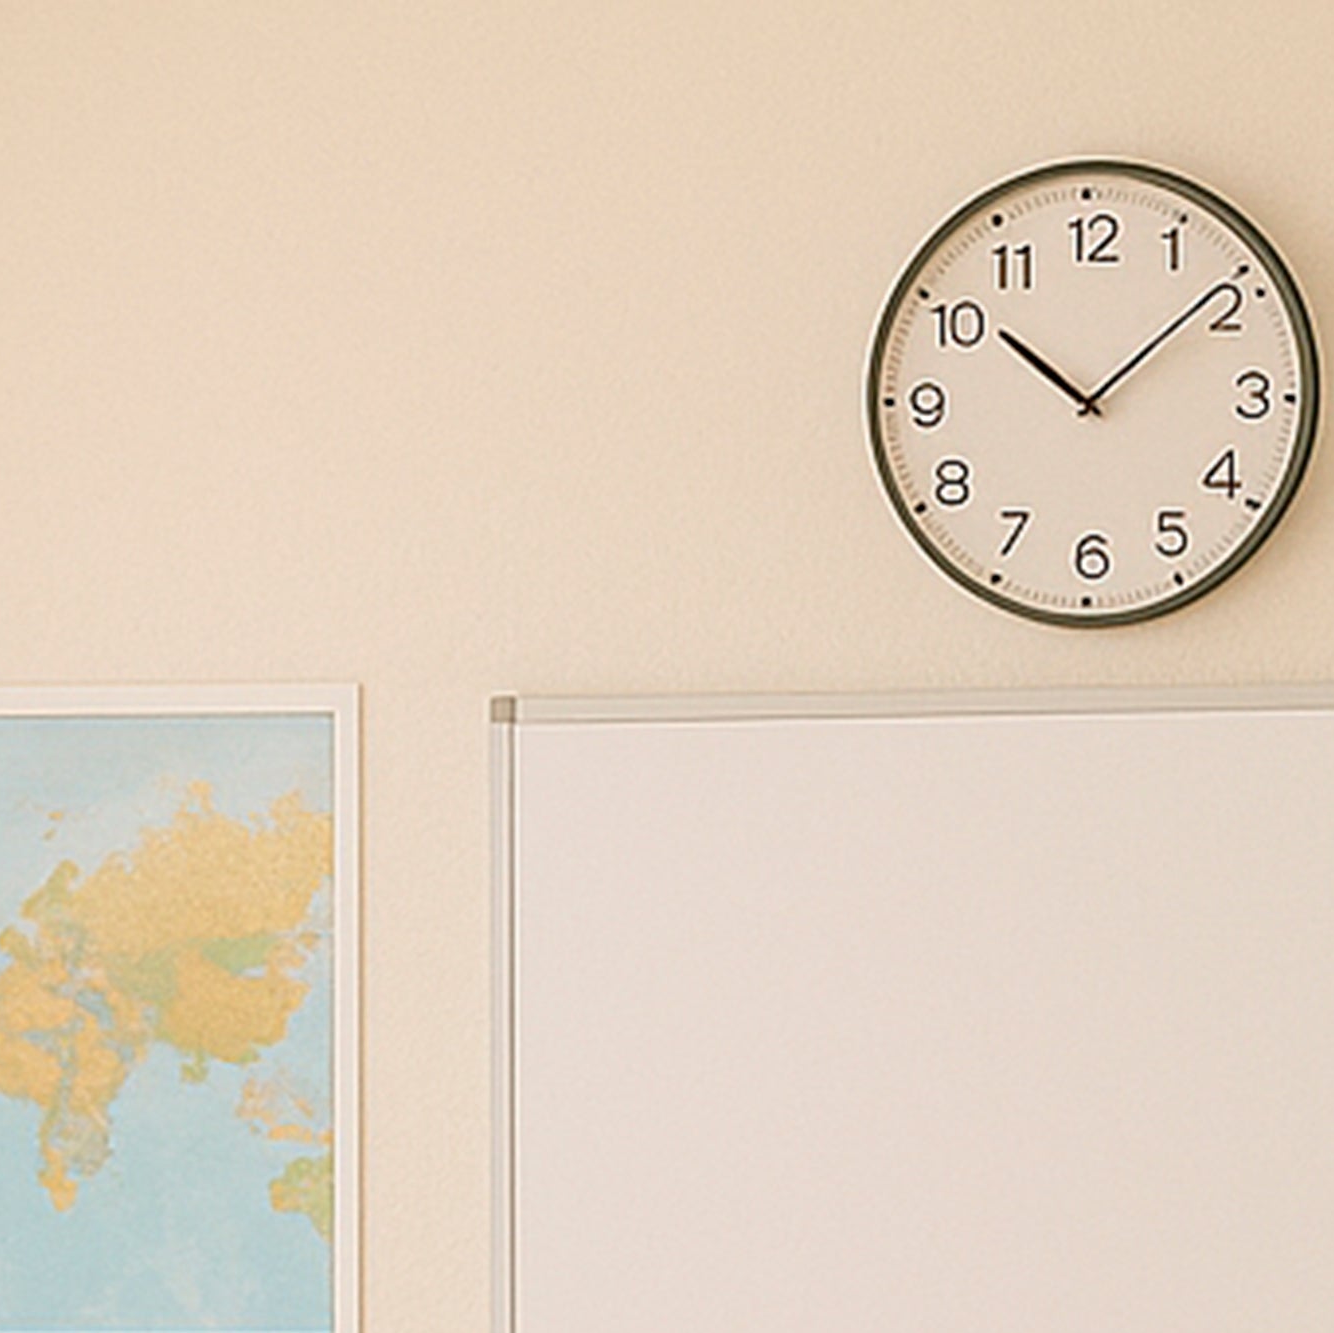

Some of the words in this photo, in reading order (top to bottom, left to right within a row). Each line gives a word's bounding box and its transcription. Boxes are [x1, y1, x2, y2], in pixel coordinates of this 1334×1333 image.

[1067, 212, 1121, 265] 12
[1160, 226, 1181, 273] 1
[990, 243, 1034, 292] 11
[929, 299, 987, 350] 10
[1208, 282, 1245, 333] 2
[908, 381, 947, 430] 9
[1234, 369, 1271, 421] 3
[934, 458, 971, 508] 8
[1201, 448, 1244, 501] 4
[999, 509, 1031, 557] 7
[1073, 533, 1111, 581] 6
[1154, 509, 1189, 559] 5
